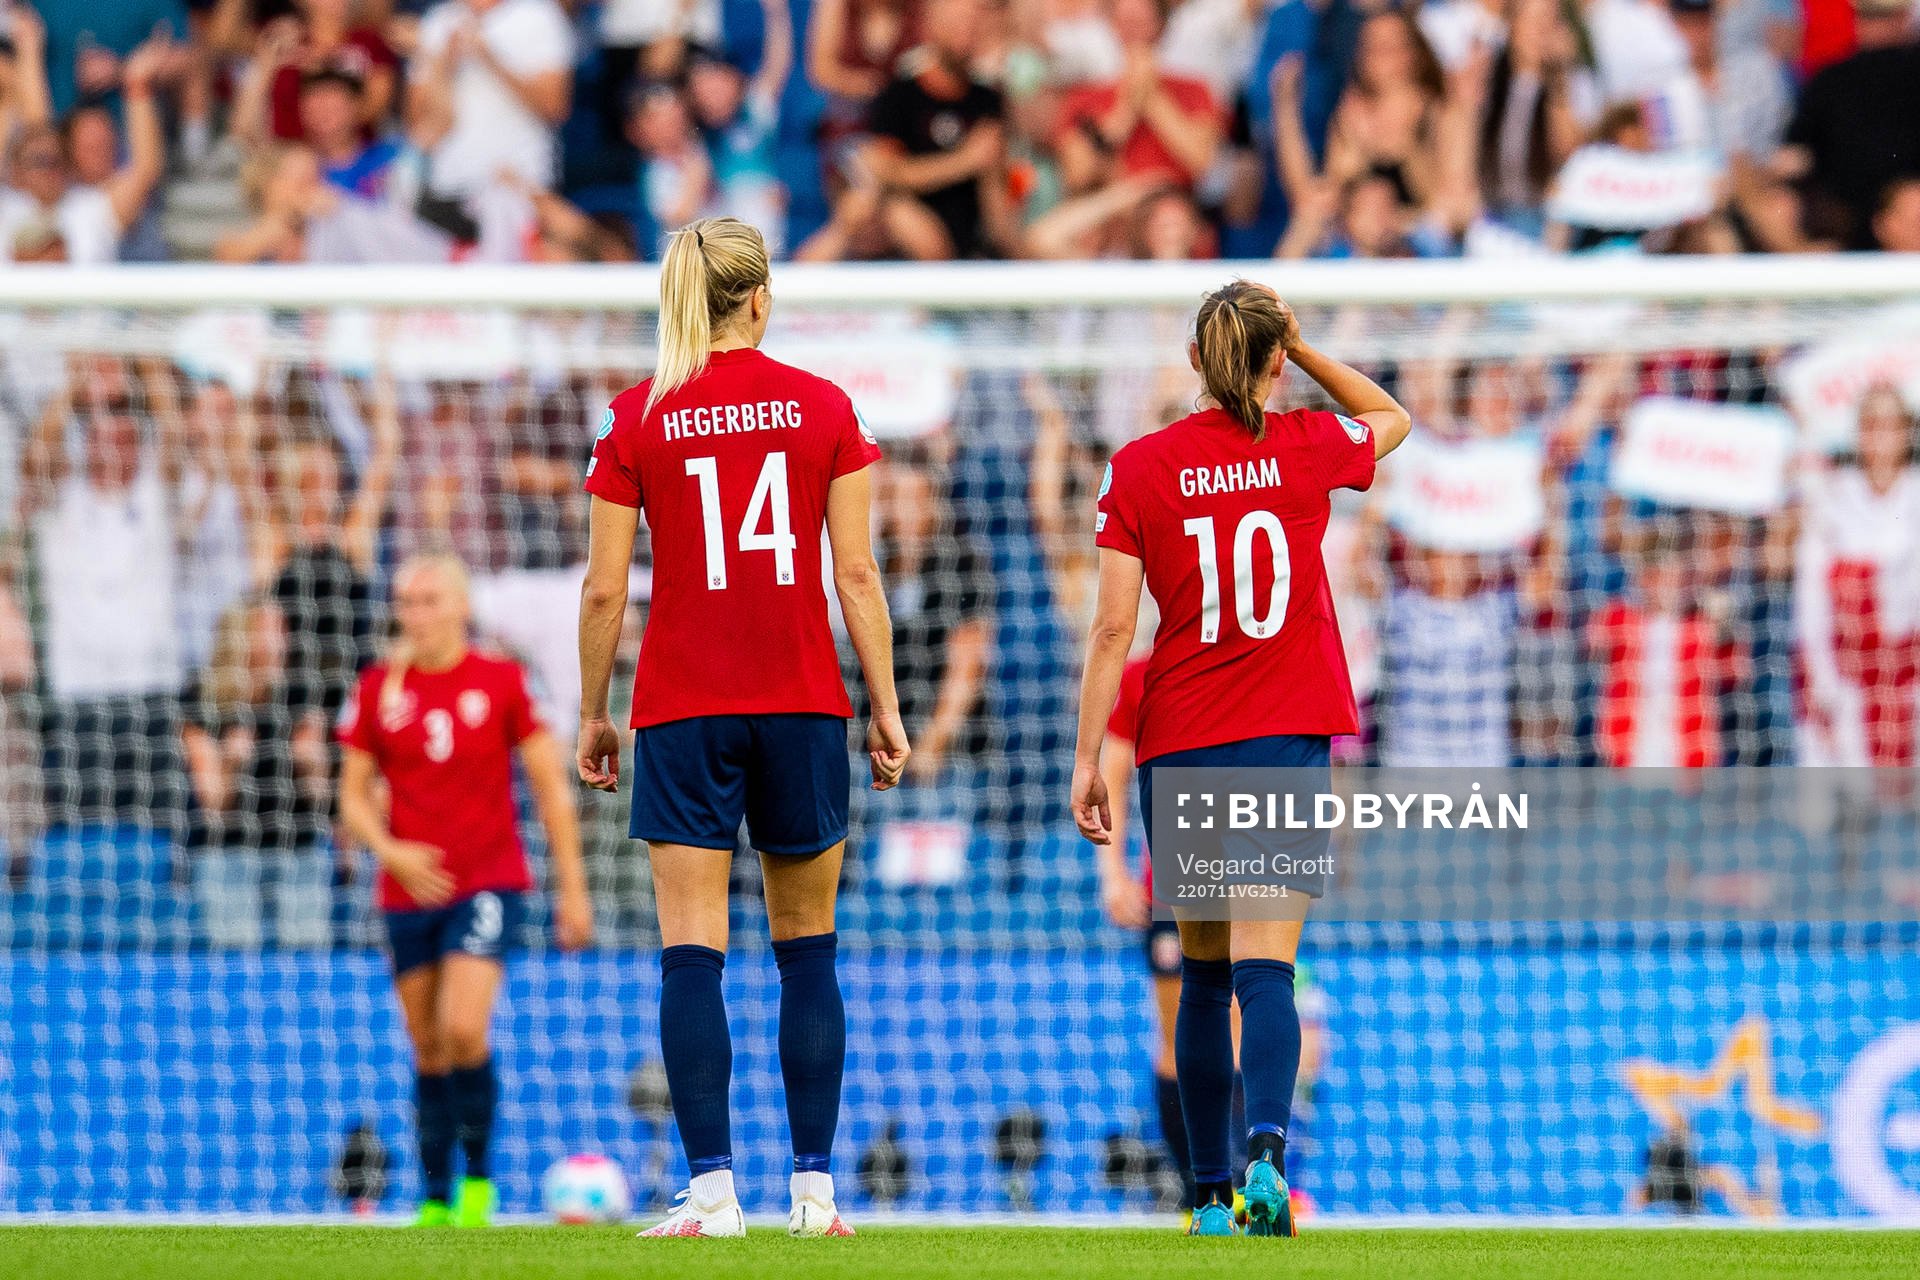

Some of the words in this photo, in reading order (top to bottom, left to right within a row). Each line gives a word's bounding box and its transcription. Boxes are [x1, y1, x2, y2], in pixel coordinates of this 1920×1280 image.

[662, 400, 802, 442] HEGERBERG
[1179, 457, 1282, 497] GRAHAM
[684, 451, 797, 591] 14
[1183, 510, 1291, 643] 10
[423, 708, 454, 762] 3
[471, 891, 503, 939] 3
